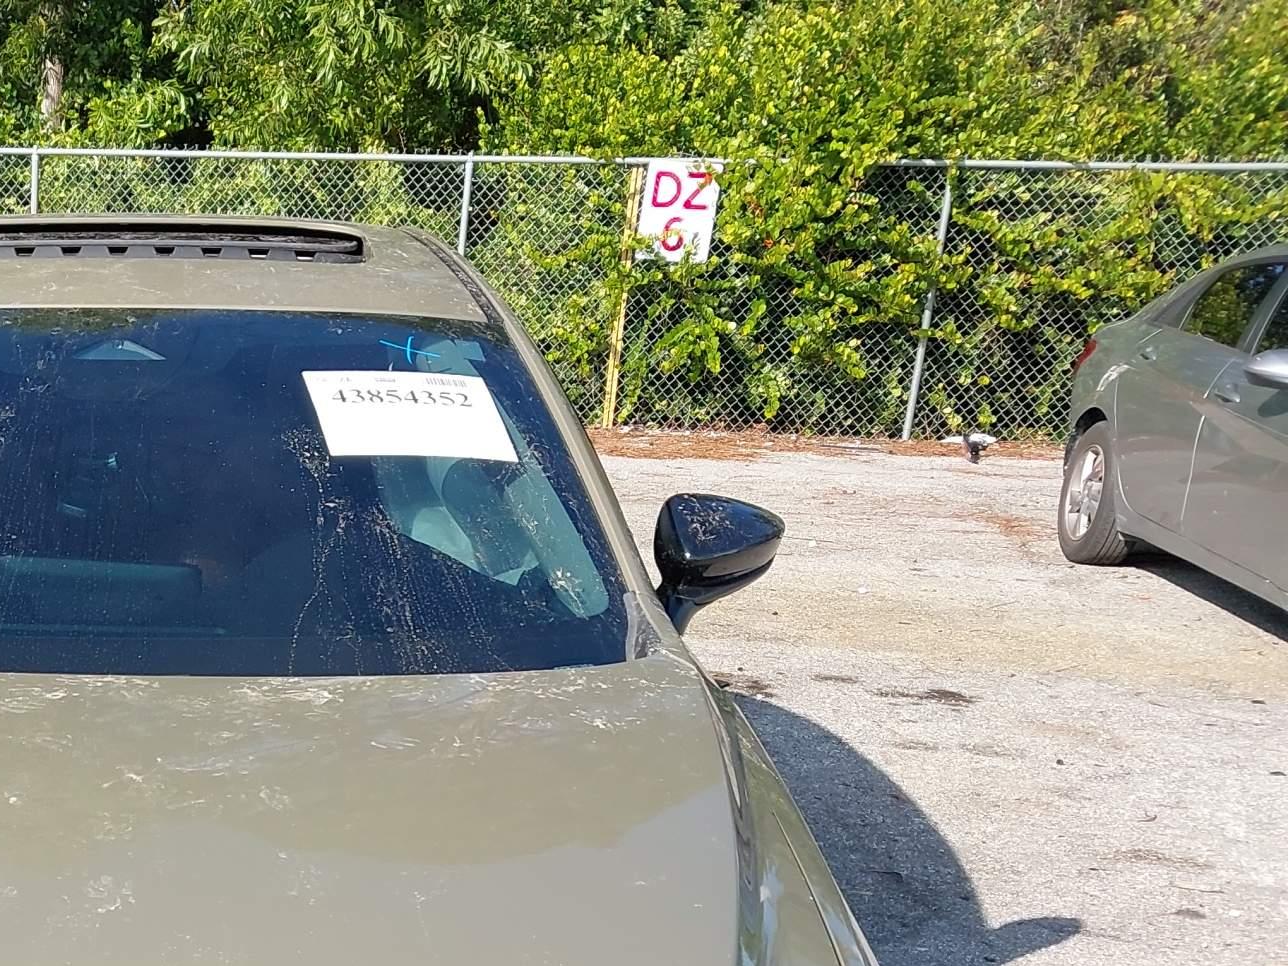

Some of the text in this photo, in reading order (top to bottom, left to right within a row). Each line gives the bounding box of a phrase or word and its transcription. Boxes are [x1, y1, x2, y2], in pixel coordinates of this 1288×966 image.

[652, 171, 713, 210] DZ
[661, 217, 684, 252] 6
[331, 388, 473, 407] 43854352
